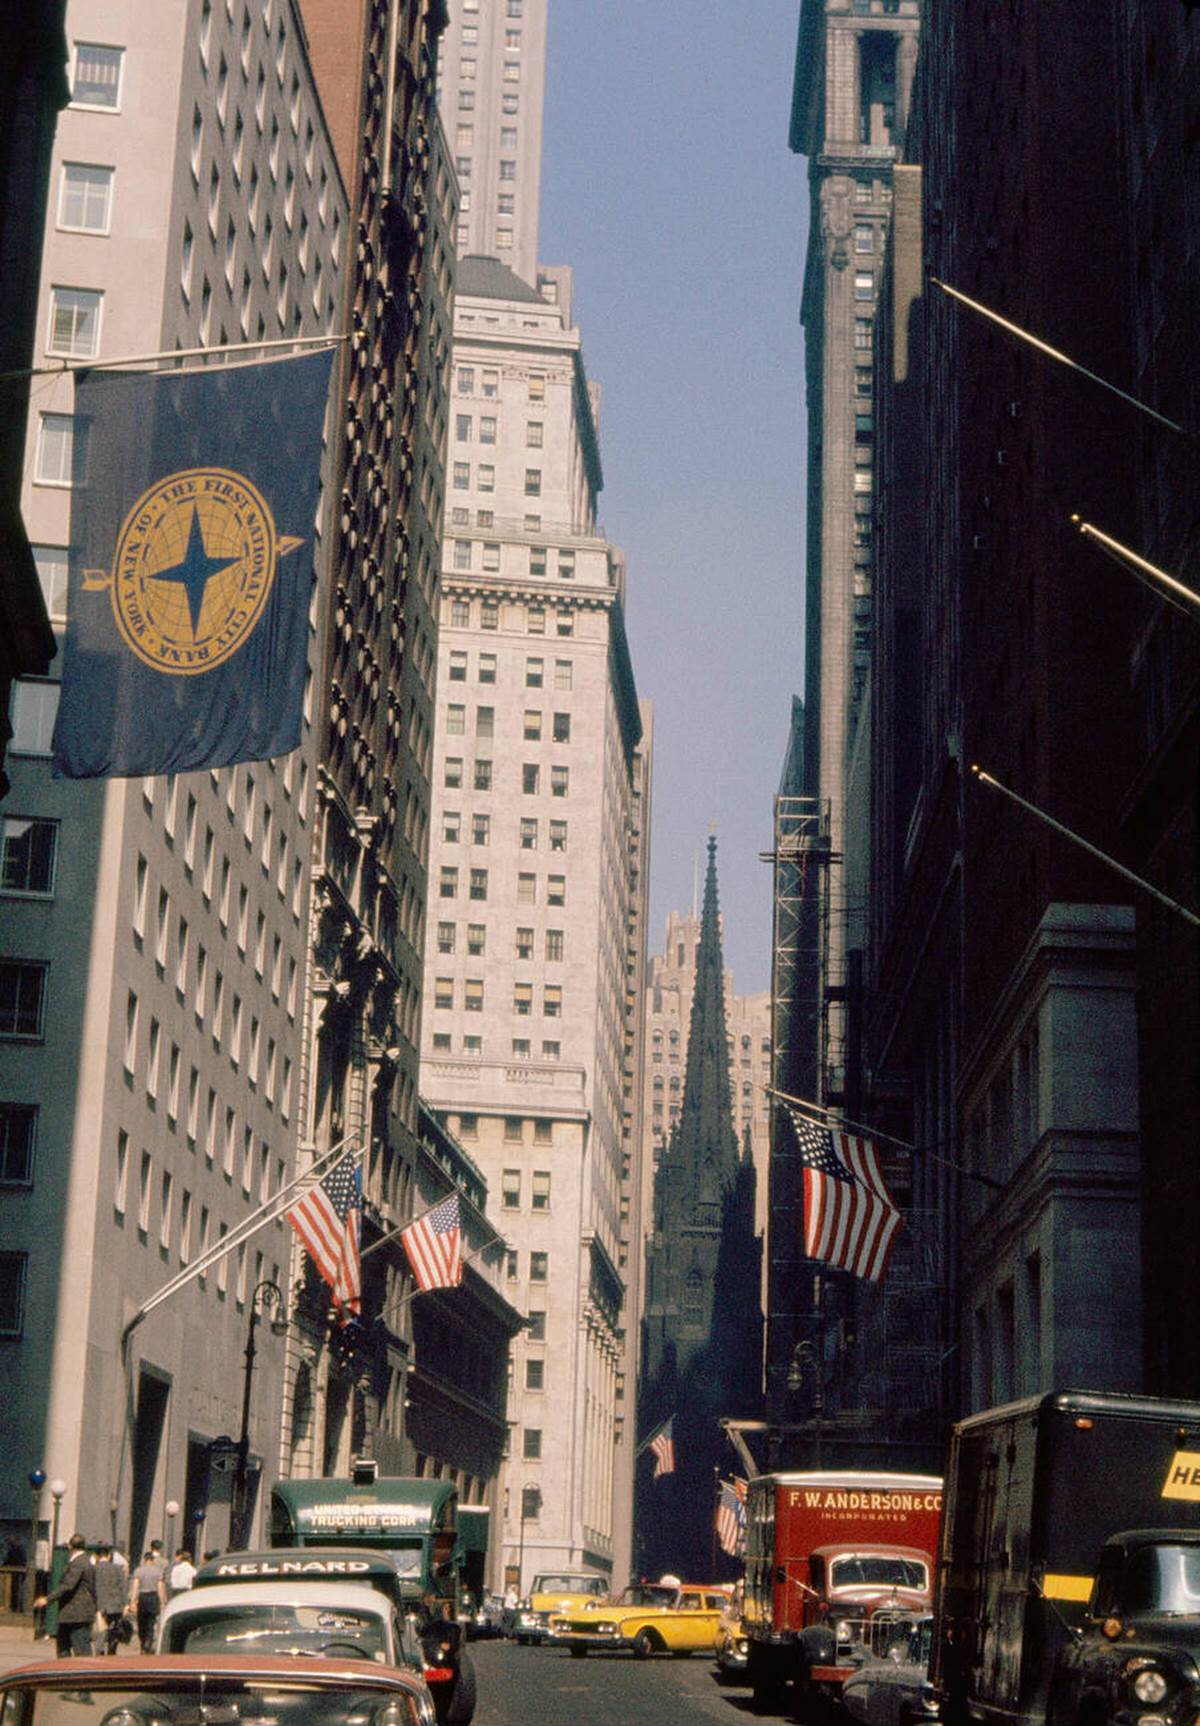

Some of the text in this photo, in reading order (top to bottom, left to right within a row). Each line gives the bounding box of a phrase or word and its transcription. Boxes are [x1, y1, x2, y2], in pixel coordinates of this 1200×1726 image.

[124, 513, 153, 638] OF NEW YORK
[158, 479, 265, 663] THE FIRST NATIONAL CITY BANK
[310, 1515, 377, 1526] TRUCKING
[218, 1562, 370, 1575] KELNARD
